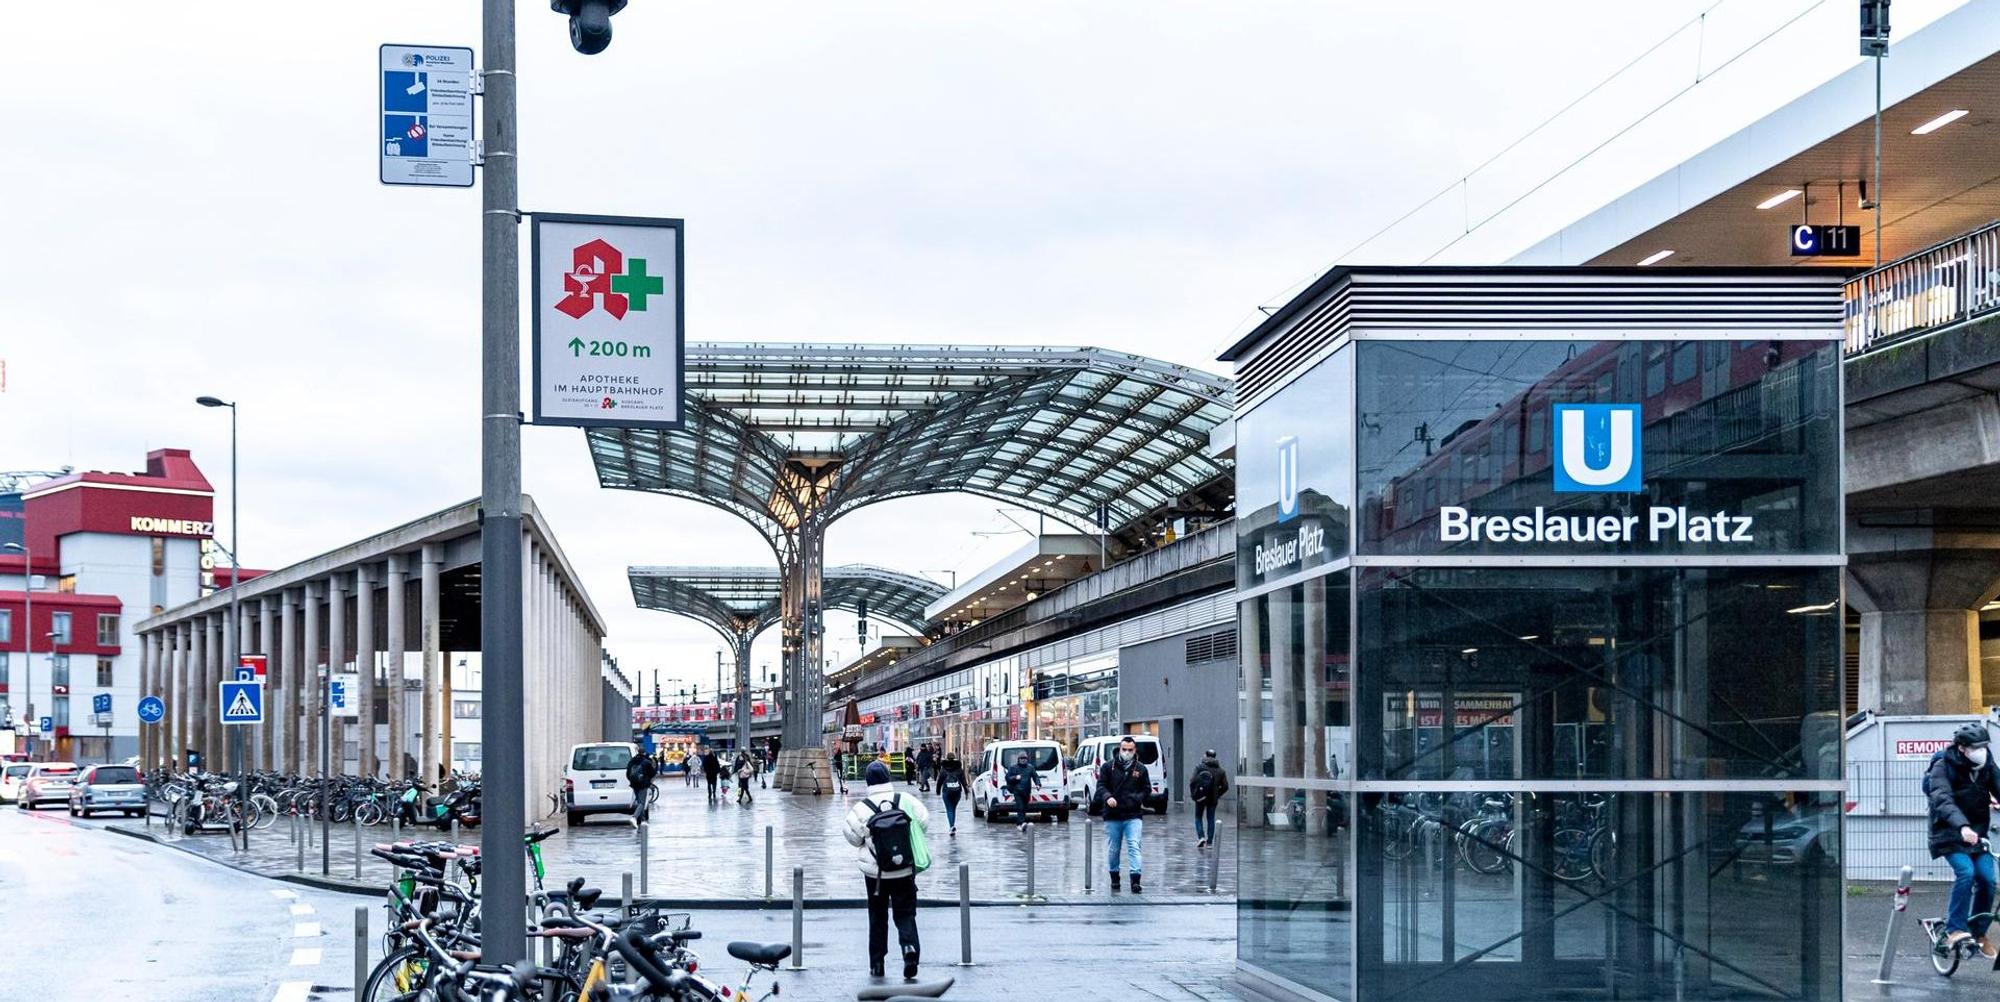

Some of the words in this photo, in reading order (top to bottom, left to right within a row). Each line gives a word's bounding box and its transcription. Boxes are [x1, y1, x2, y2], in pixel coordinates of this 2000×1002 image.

[1795, 225, 1813, 249] C
[1827, 227, 1847, 249] 11
[590, 340, 628, 358] 200
[633, 345, 651, 358] m
[580, 374, 639, 384] APOTHEKE
[554, 384, 567, 393] IM
[571, 385, 664, 396] HAUPTBAHNHOF
[1562, 409, 1633, 486] U
[1280, 442, 1297, 515] U
[131, 516, 214, 535] KOMMERZ
[1440, 506, 1639, 542] Breslauer
[1649, 506, 1754, 542] Platz
[1255, 538, 1298, 576] Breslauer
[1298, 525, 1325, 560] Platz
[1421, 716, 1437, 725] IST
